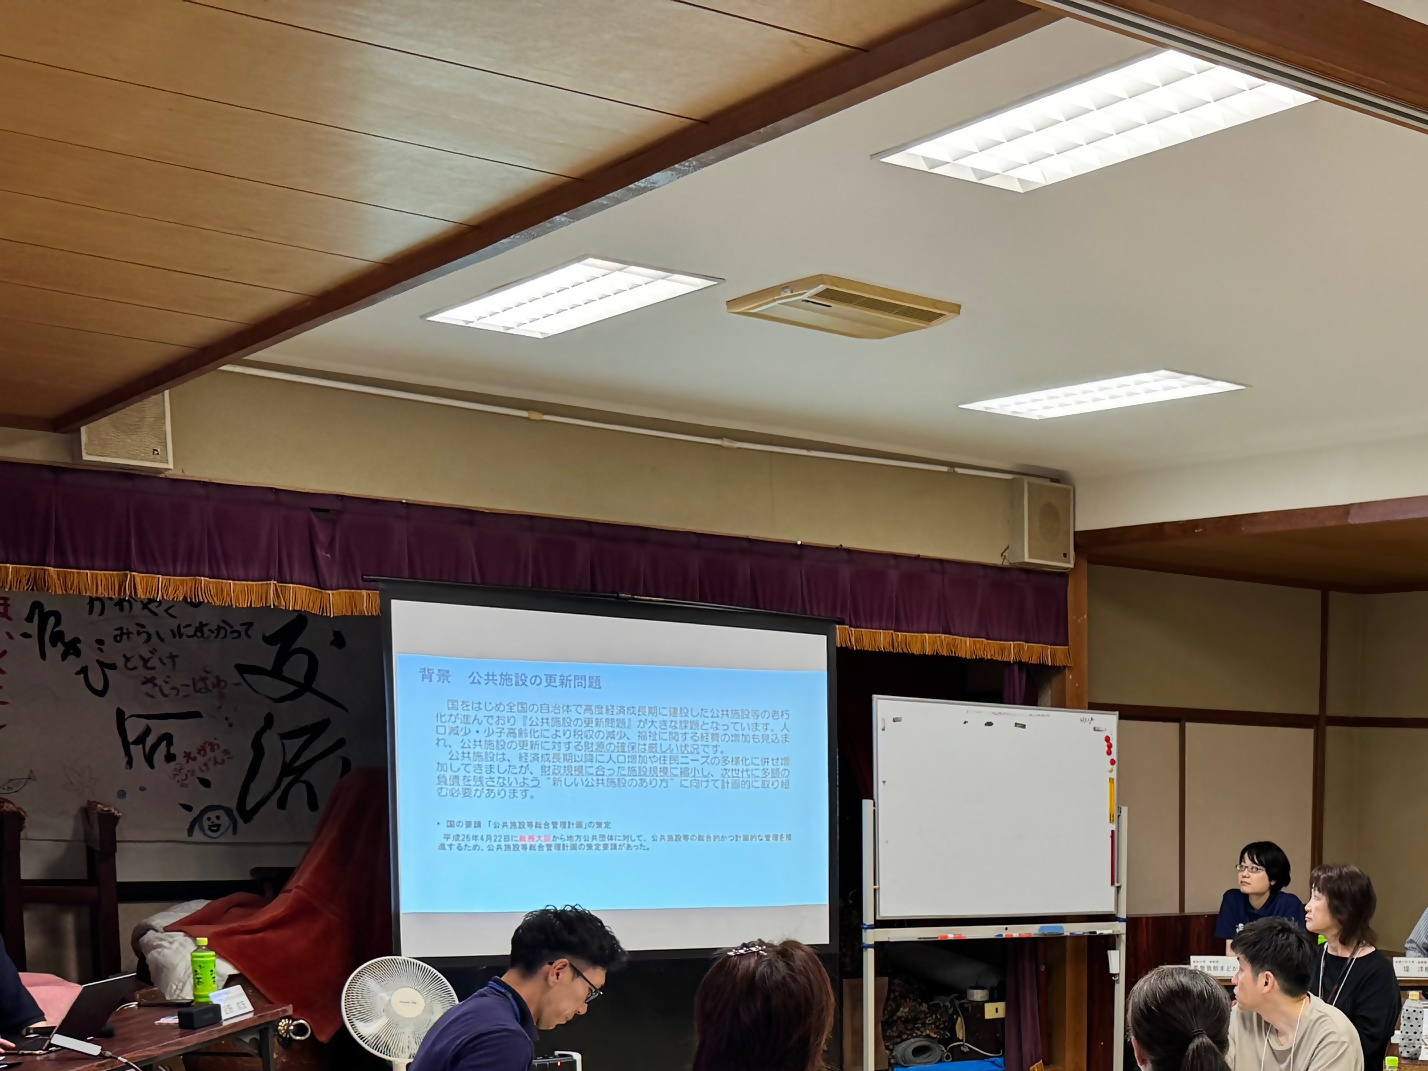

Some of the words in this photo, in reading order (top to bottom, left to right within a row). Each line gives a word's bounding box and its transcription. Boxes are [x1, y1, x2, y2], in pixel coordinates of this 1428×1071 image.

[113, 619, 255, 644] みらいにむかって
[418, 667, 452, 685] 背景
[467, 671, 602, 690] 公共施設の更新問題
[436, 786, 536, 801] む必要があります。
